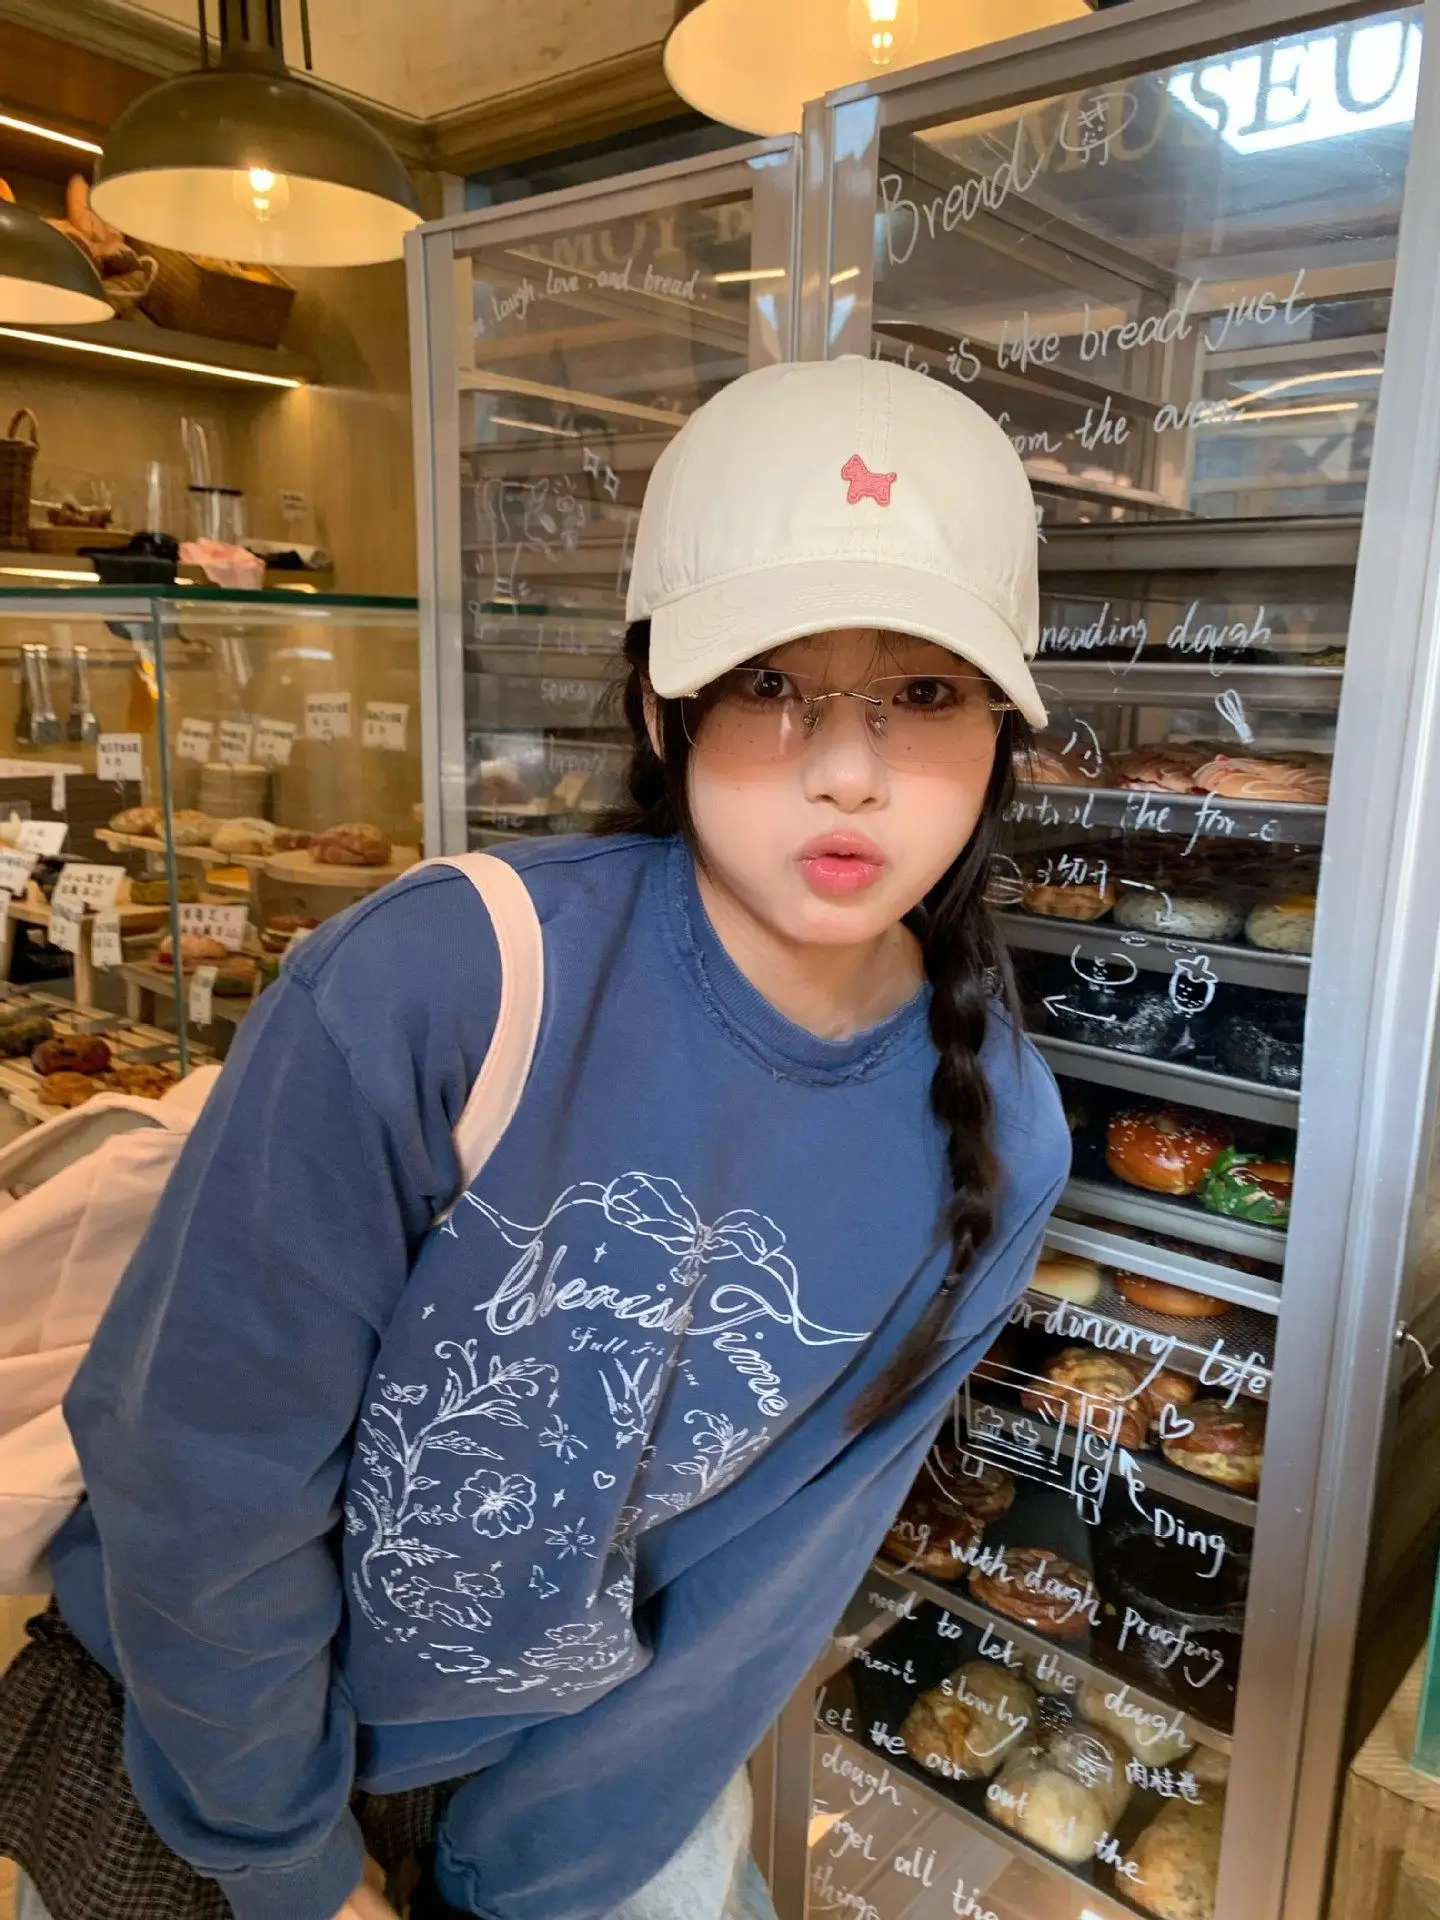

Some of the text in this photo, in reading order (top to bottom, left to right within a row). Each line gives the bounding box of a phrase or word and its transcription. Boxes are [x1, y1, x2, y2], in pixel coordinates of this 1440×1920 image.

[880, 114, 1046, 266] Bread
[1080, 277, 1202, 361] bread
[1205, 269, 1315, 351] just
[1075, 395, 1131, 450] the
[950, 1537, 1015, 1584] with
[1024, 1559, 1101, 1627] dough
[1154, 1508, 1228, 1579] Ding
[936, 1609, 964, 1640] to
[1036, 1653, 1079, 1696] the
[1104, 1684, 1194, 1748] dough
[893, 1844, 940, 1889] all
